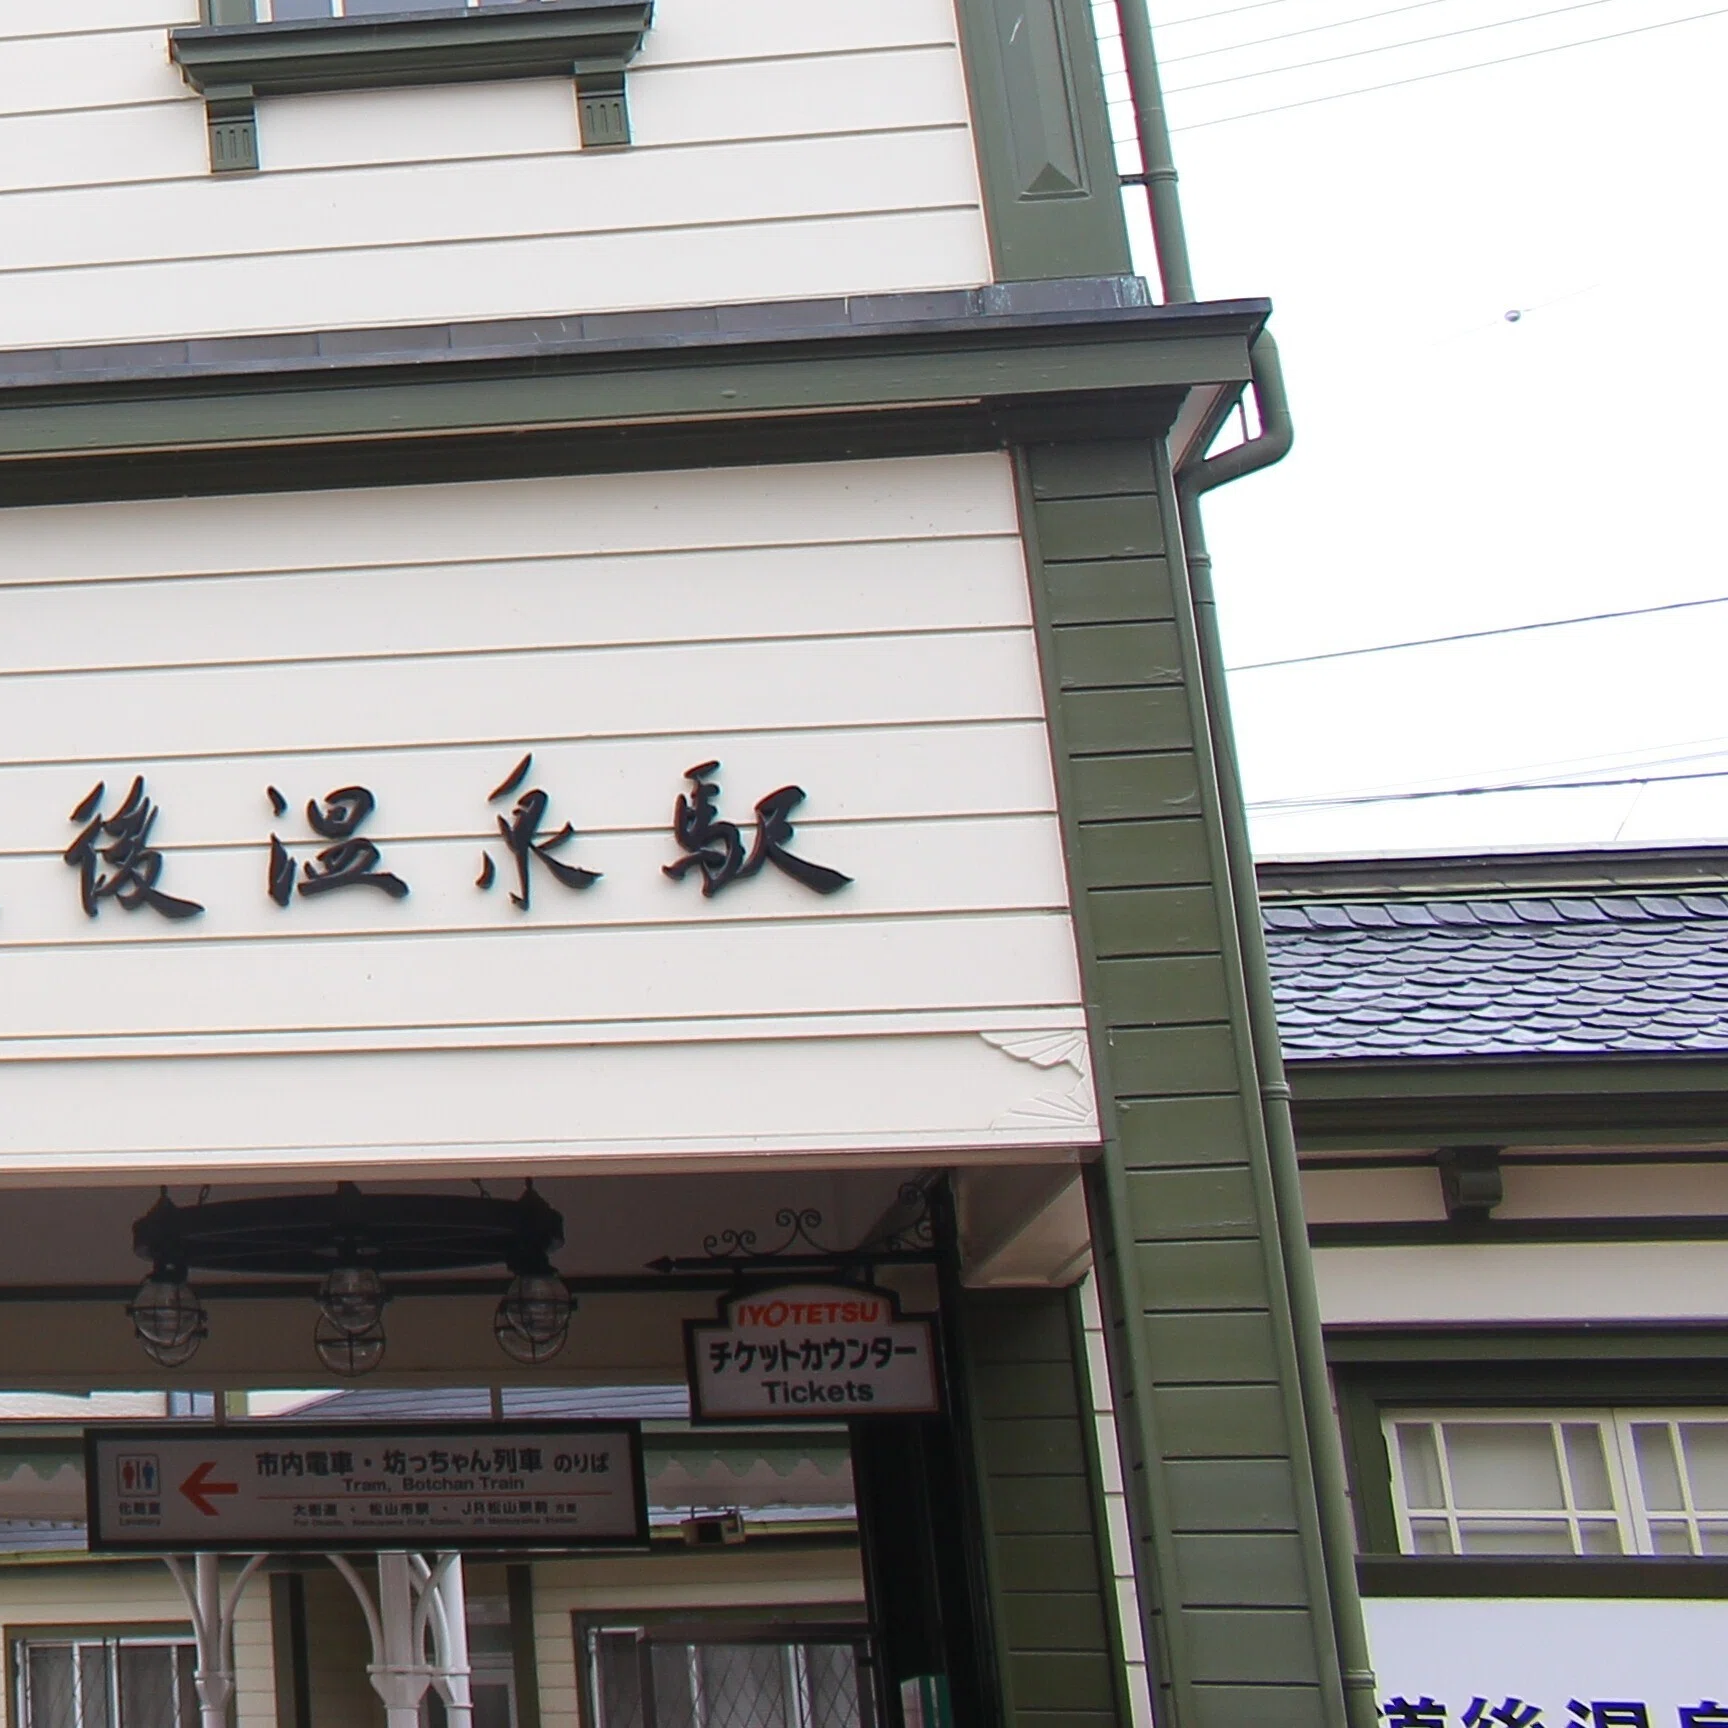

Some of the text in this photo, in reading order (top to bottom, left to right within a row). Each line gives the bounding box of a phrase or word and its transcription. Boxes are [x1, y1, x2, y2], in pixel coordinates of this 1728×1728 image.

[737, 1300, 879, 1328] IYOTETSU
[709, 1337, 917, 1373] チケットカウンター
[761, 1380, 874, 1404] Tickets
[554, 1452, 609, 1473] のりば
[343, 1476, 525, 1493] Tram, Botchan Train
